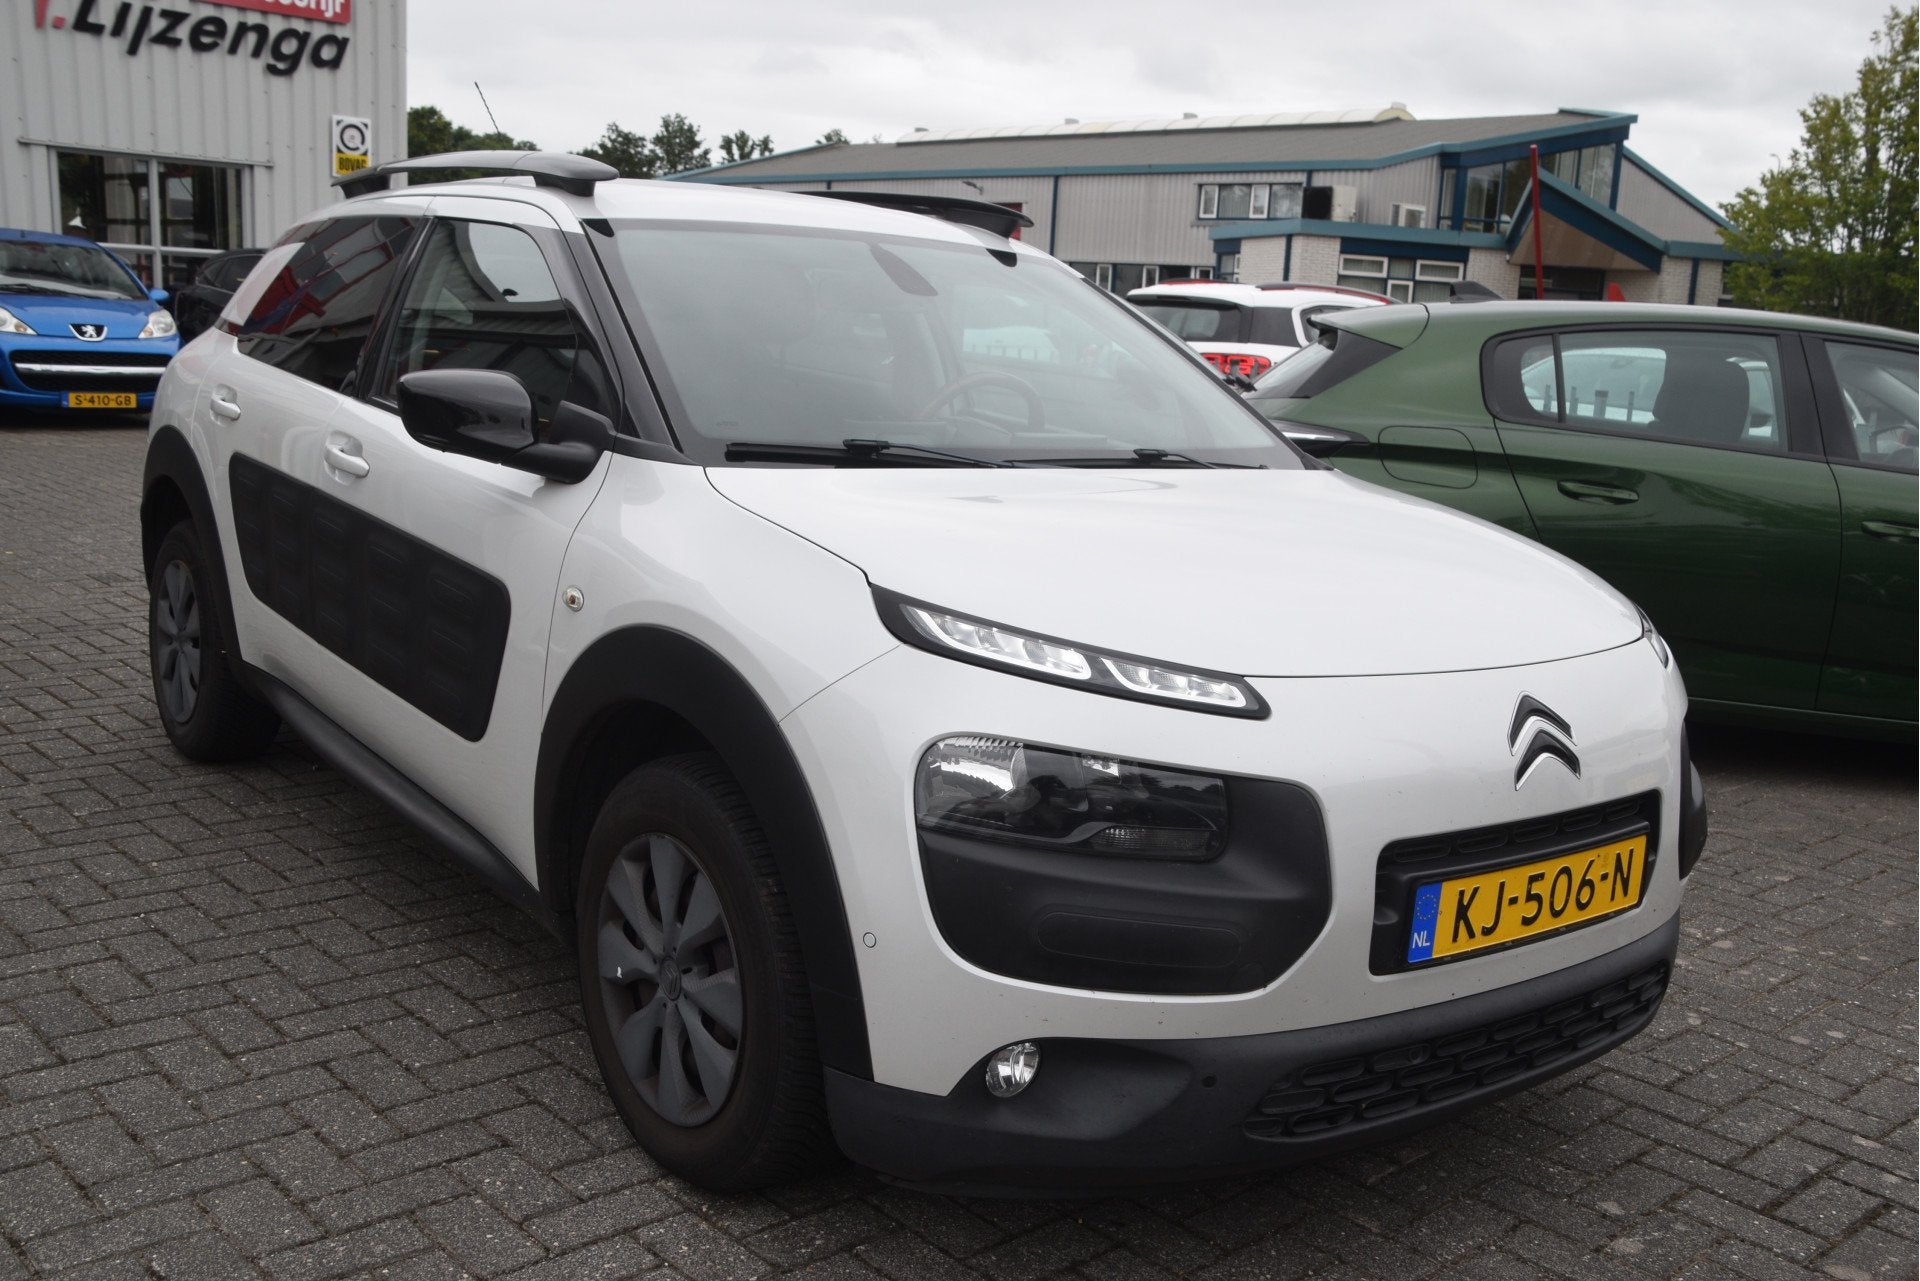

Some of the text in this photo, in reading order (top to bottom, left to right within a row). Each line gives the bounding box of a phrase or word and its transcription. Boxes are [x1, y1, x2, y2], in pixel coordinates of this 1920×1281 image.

[72, 0, 349, 76] Lijzenga
[75, 394, 132, 406] S-410-GB
[1452, 848, 1634, 943] KJ-506-N
[1412, 931, 1431, 948] NL
